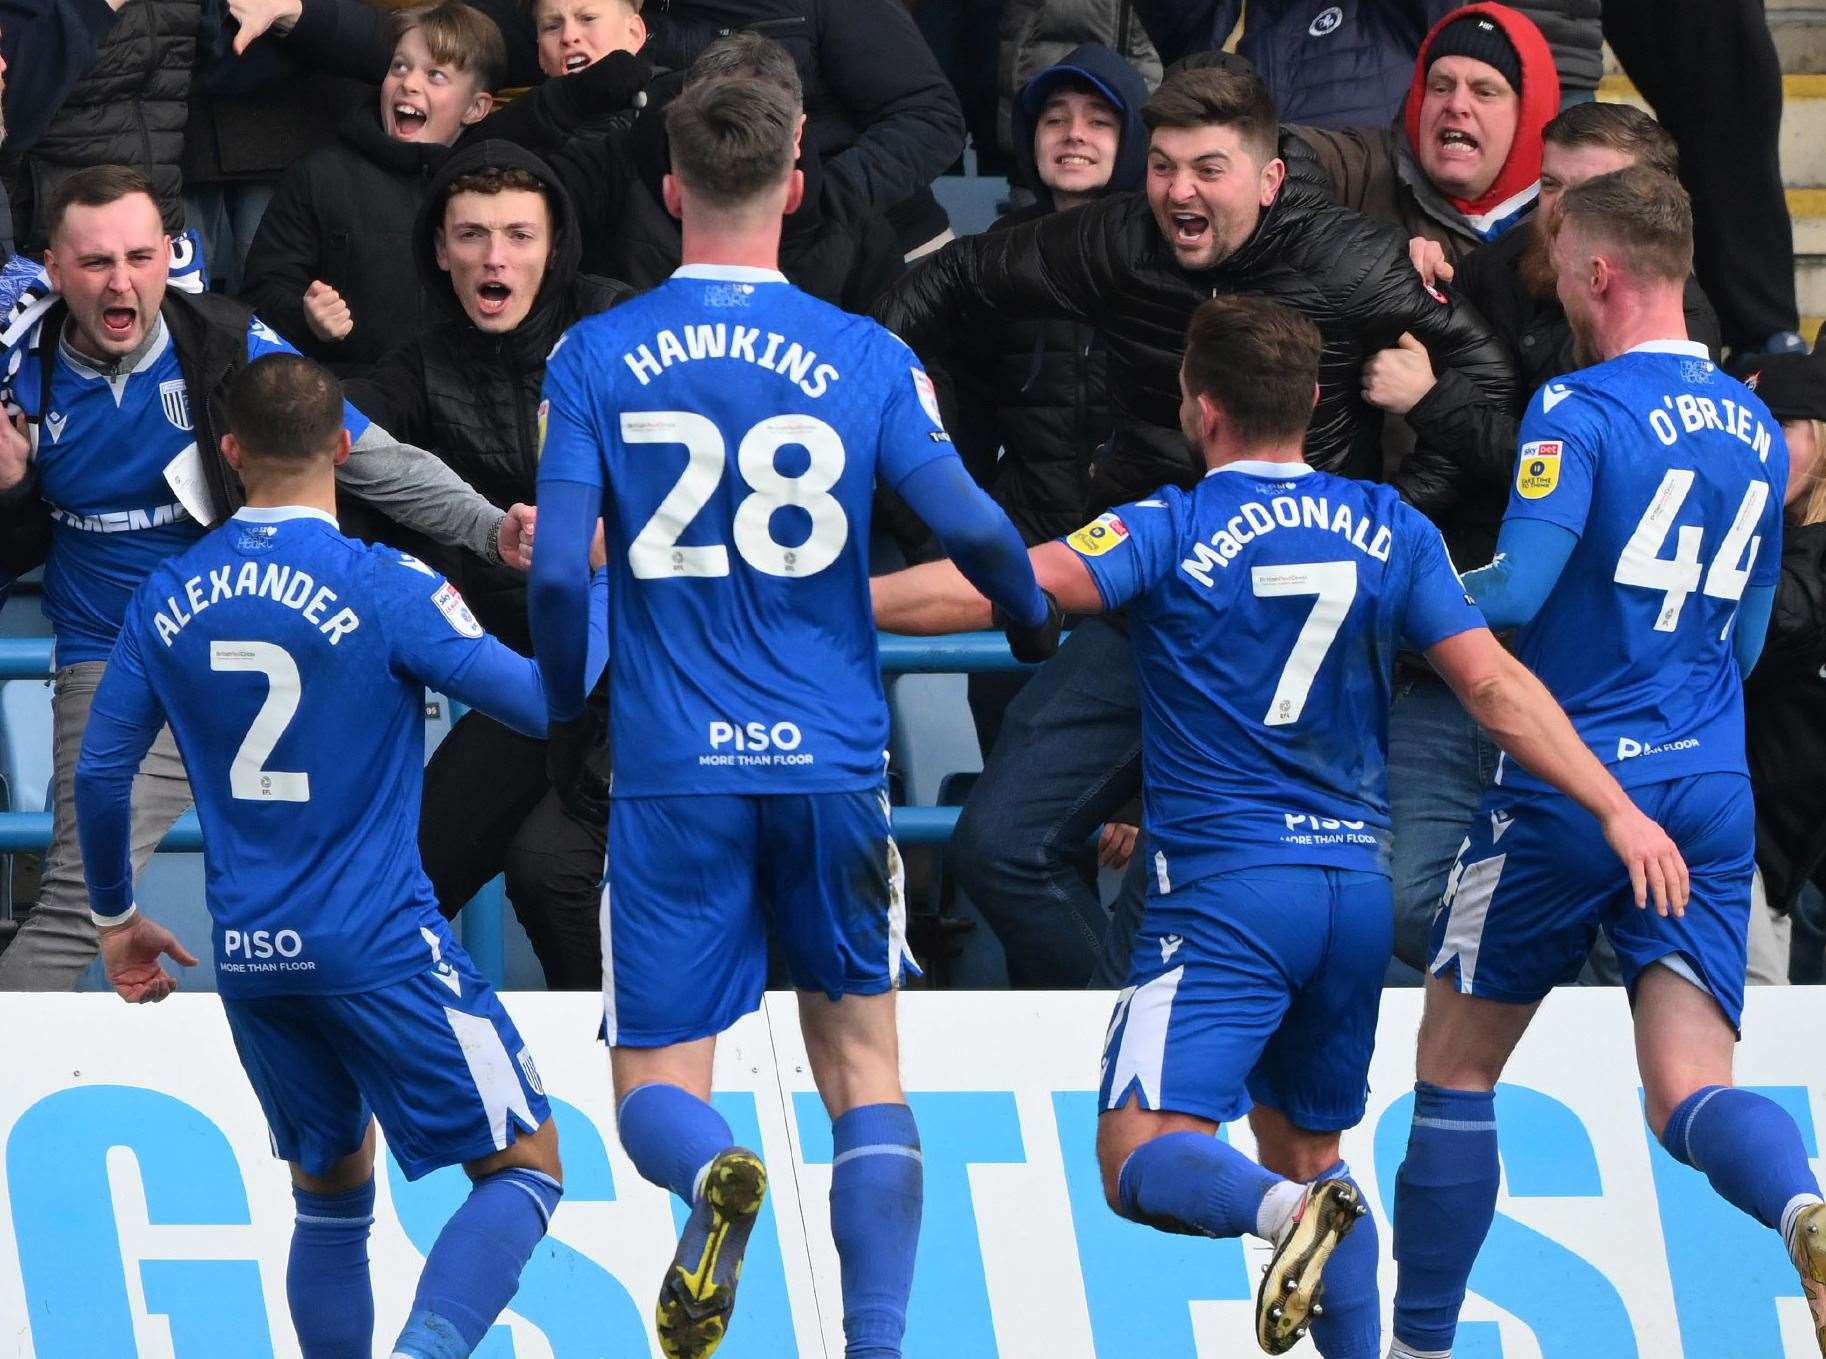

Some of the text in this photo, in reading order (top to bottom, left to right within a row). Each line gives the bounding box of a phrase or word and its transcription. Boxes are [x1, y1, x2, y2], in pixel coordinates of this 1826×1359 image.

[623, 322, 840, 399] HAWKINS
[1649, 393, 1772, 464] O'BRIEN
[619, 410, 849, 580] 28
[1181, 496, 1393, 588] MacDONALD
[1613, 468, 1769, 641] 44
[153, 561, 361, 648] ALEXANDER
[1251, 560, 1358, 726] 7
[209, 639, 311, 803] 2
[708, 721, 802, 752] PISO
[1663, 738, 1700, 752] FLOOR
[698, 753, 814, 766] MORE THAN FLOOR
[1314, 834, 1344, 844] THAN
[219, 961, 316, 973] MORE THAN FLOOR
[225, 929, 302, 959] PISO
